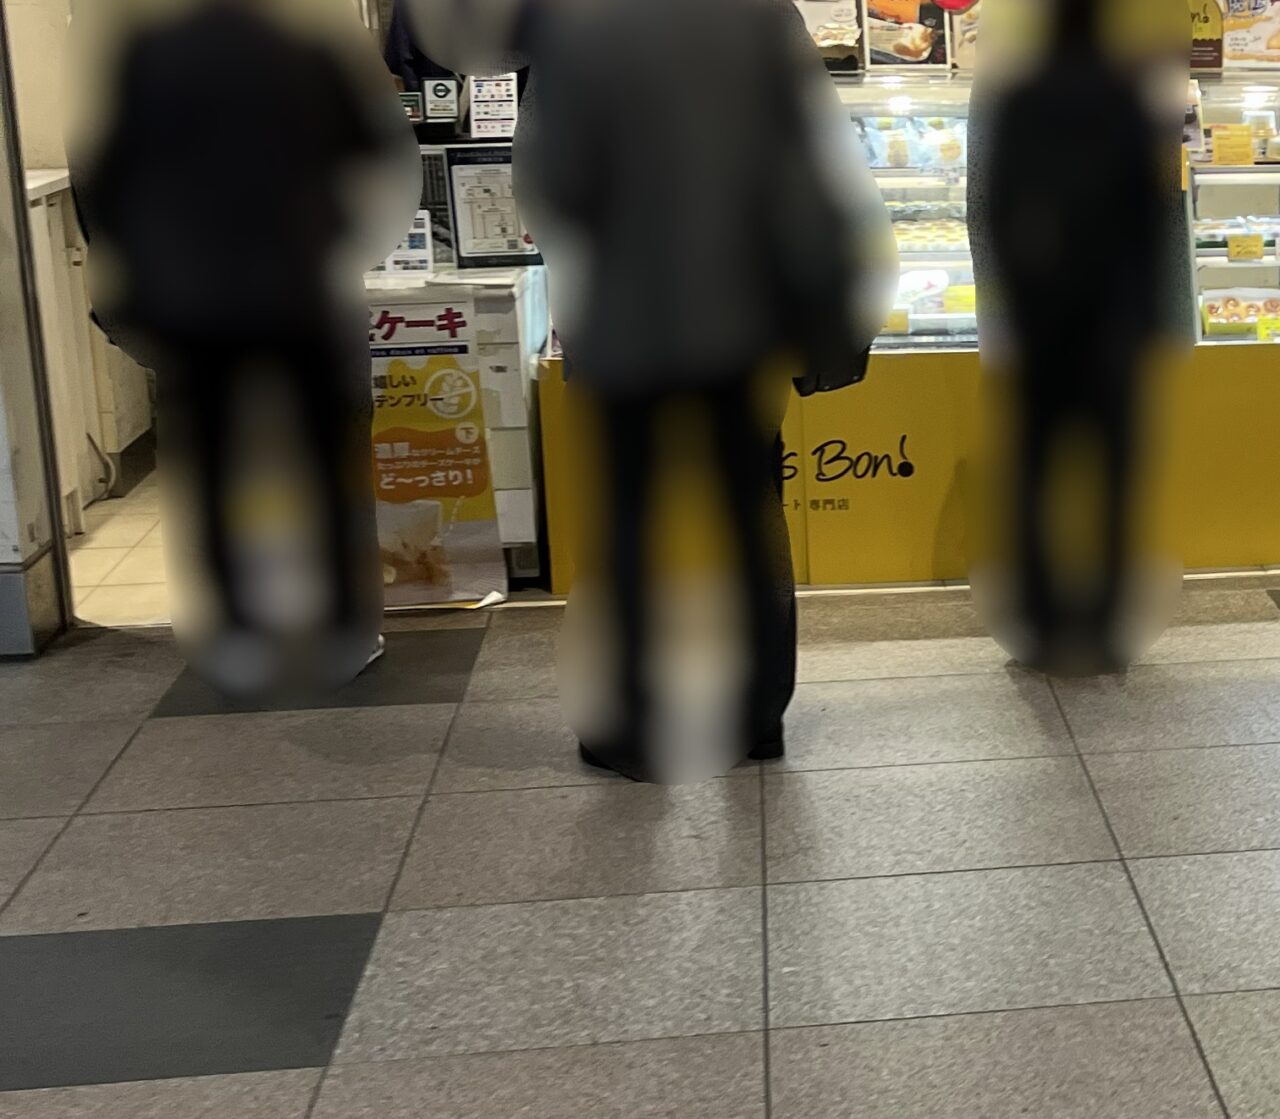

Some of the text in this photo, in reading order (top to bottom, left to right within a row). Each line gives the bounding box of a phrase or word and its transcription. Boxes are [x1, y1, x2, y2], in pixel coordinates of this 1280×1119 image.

[374, 307, 467, 341] ケーキ
[811, 434, 914, 483] Bon!
